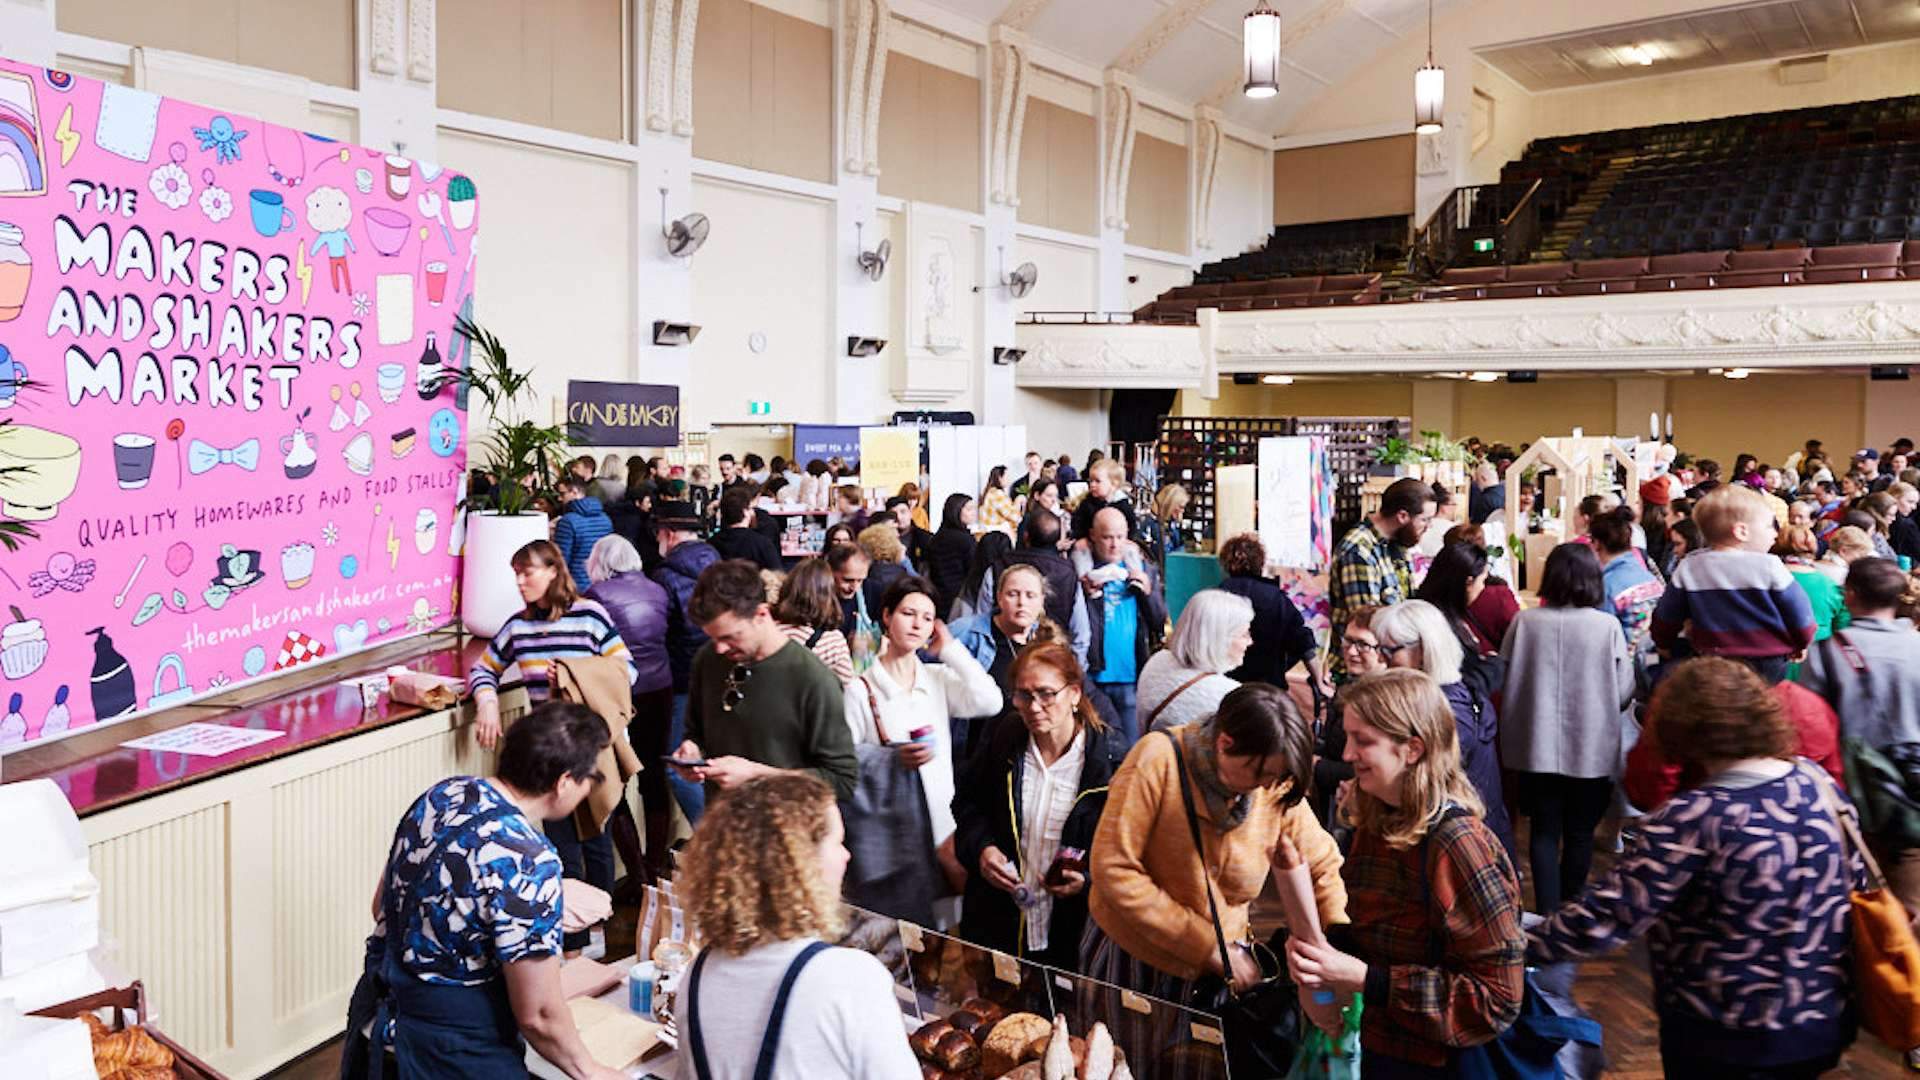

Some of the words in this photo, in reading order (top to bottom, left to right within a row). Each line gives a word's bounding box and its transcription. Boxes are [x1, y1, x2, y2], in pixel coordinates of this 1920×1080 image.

[68, 179, 138, 218] THE
[54, 214, 290, 305] MAKERS
[64, 344, 301, 412] MARKET
[78, 508, 178, 548] QUALITY
[195, 494, 305, 528] HOMEWARES
[319, 487, 352, 509] AND
[365, 476, 398, 499] FOOD
[407, 470, 454, 494] STALLS
